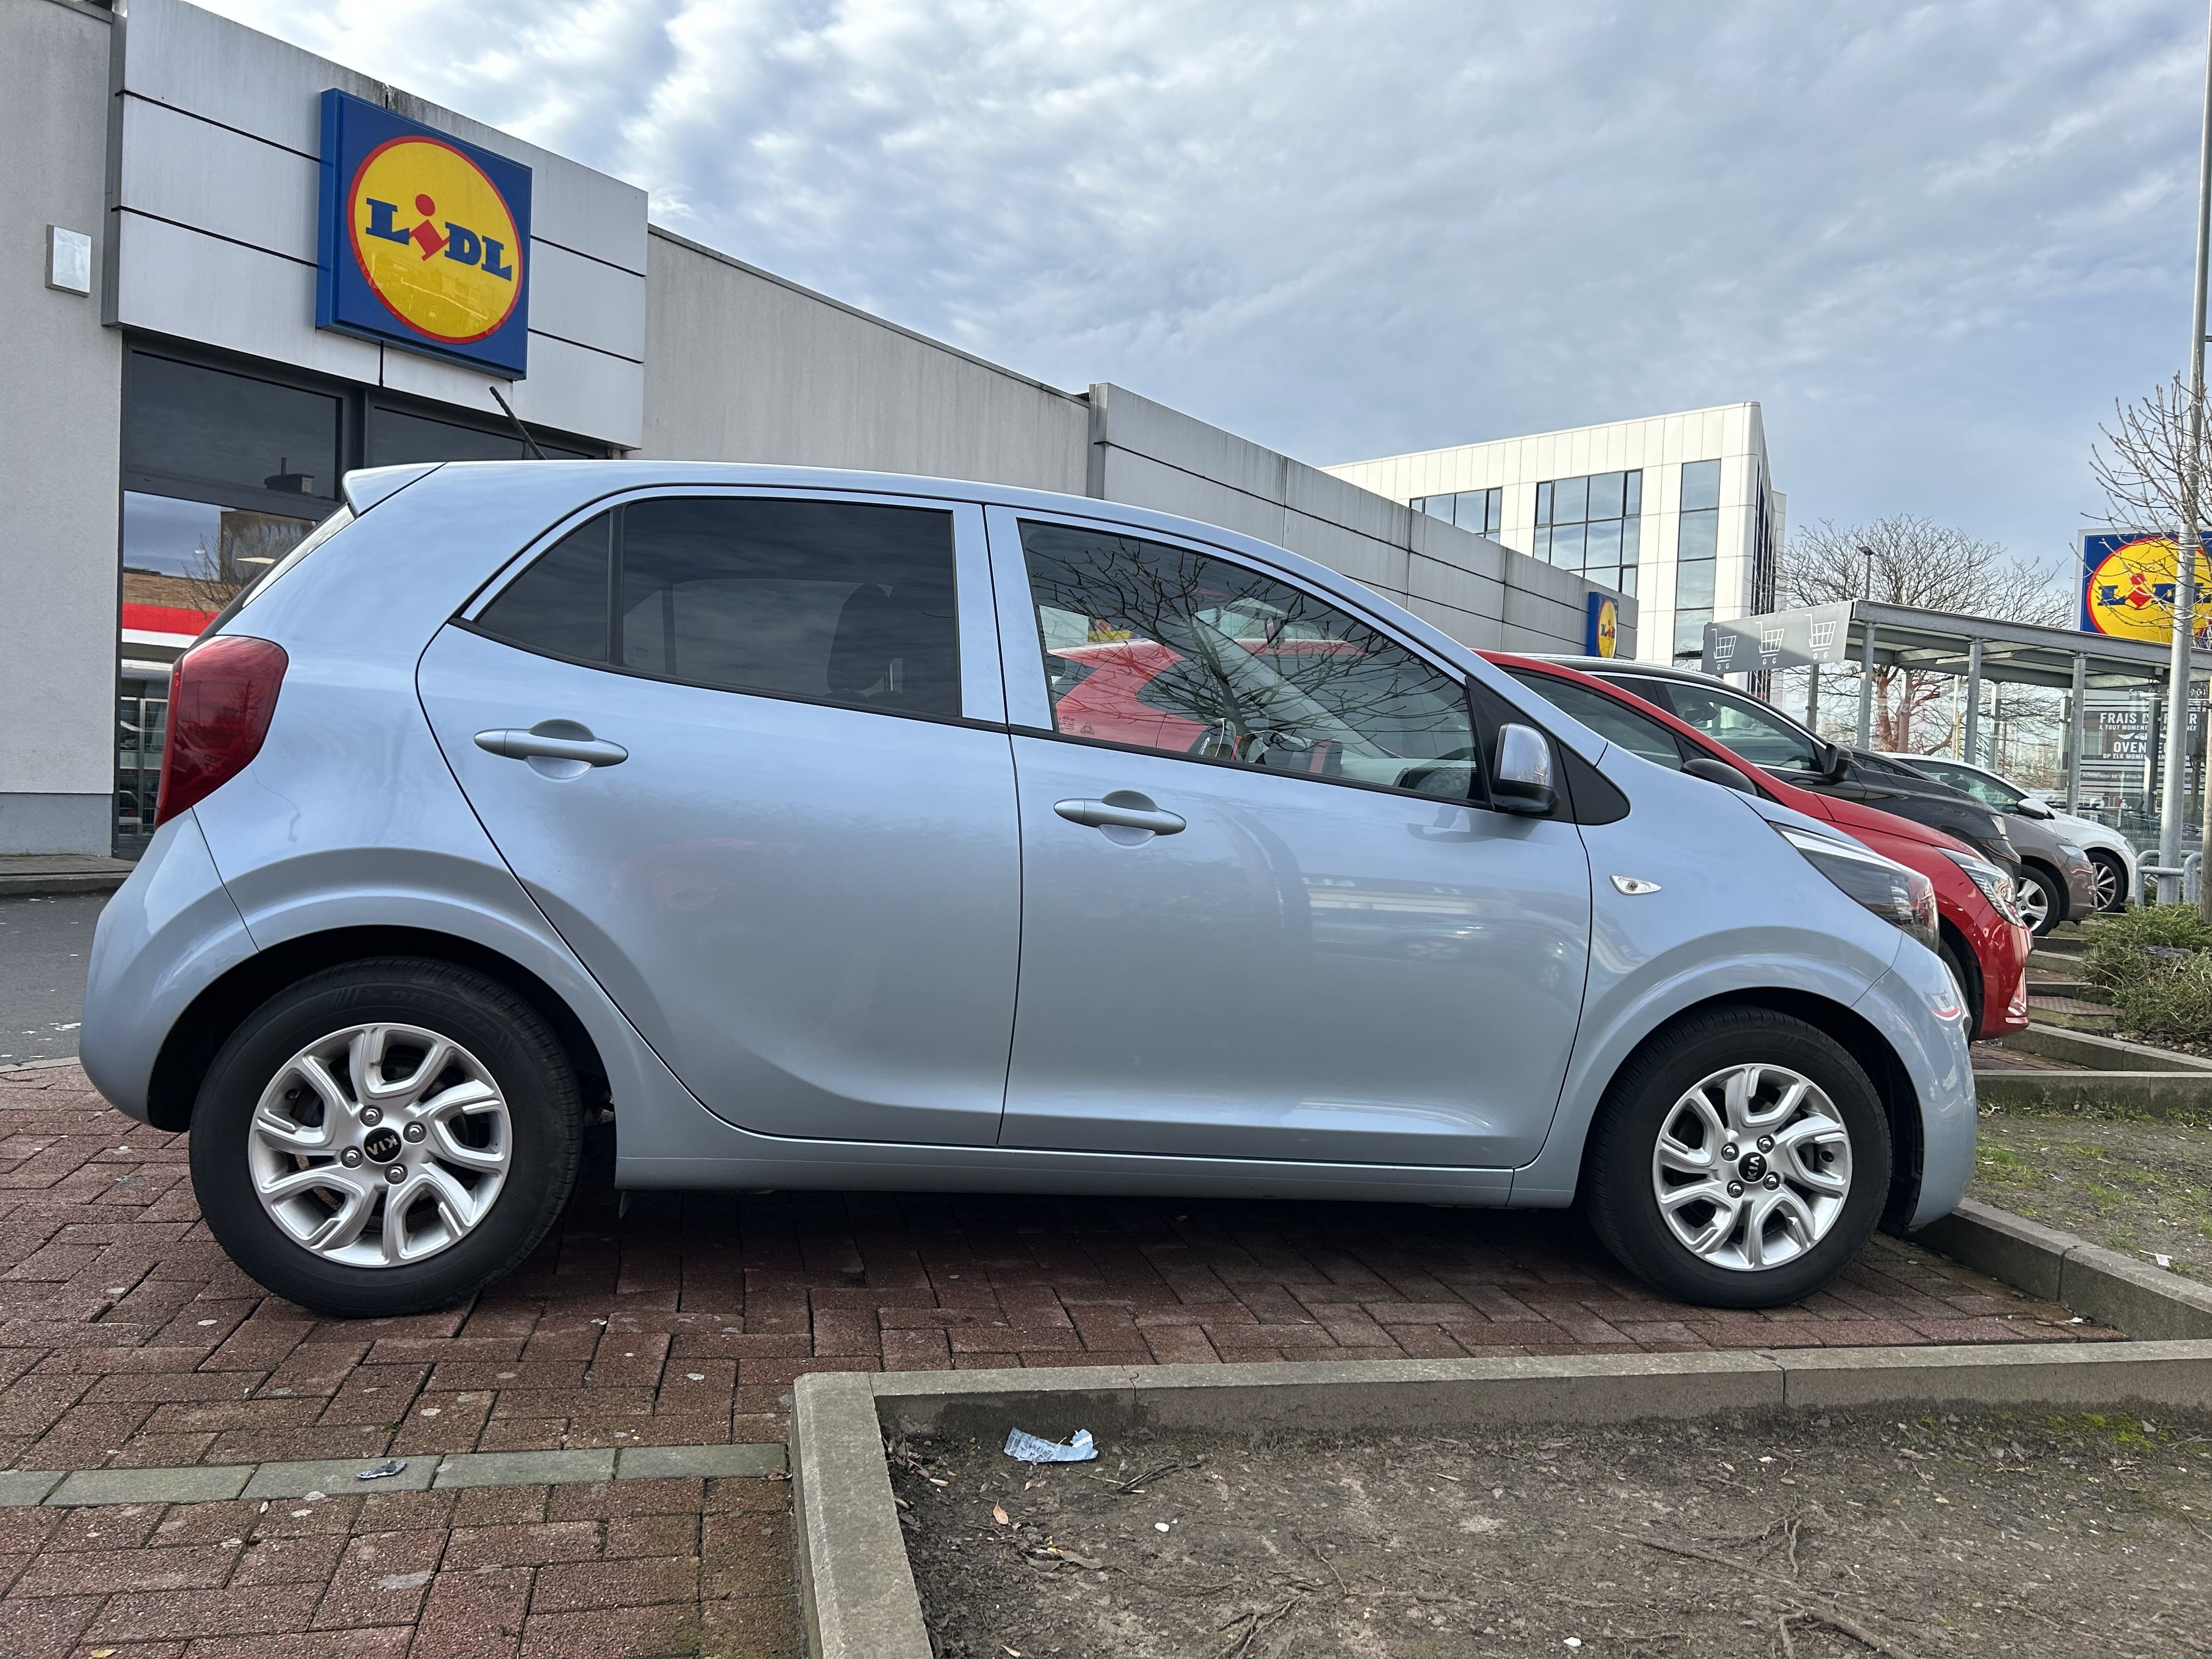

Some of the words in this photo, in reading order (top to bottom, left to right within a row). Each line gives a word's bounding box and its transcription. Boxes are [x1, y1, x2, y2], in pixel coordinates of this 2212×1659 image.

[2100, 712, 2137, 724] FRAIS
[367, 1135, 398, 1156] KIA
[1747, 1156, 1760, 1180] KIA
